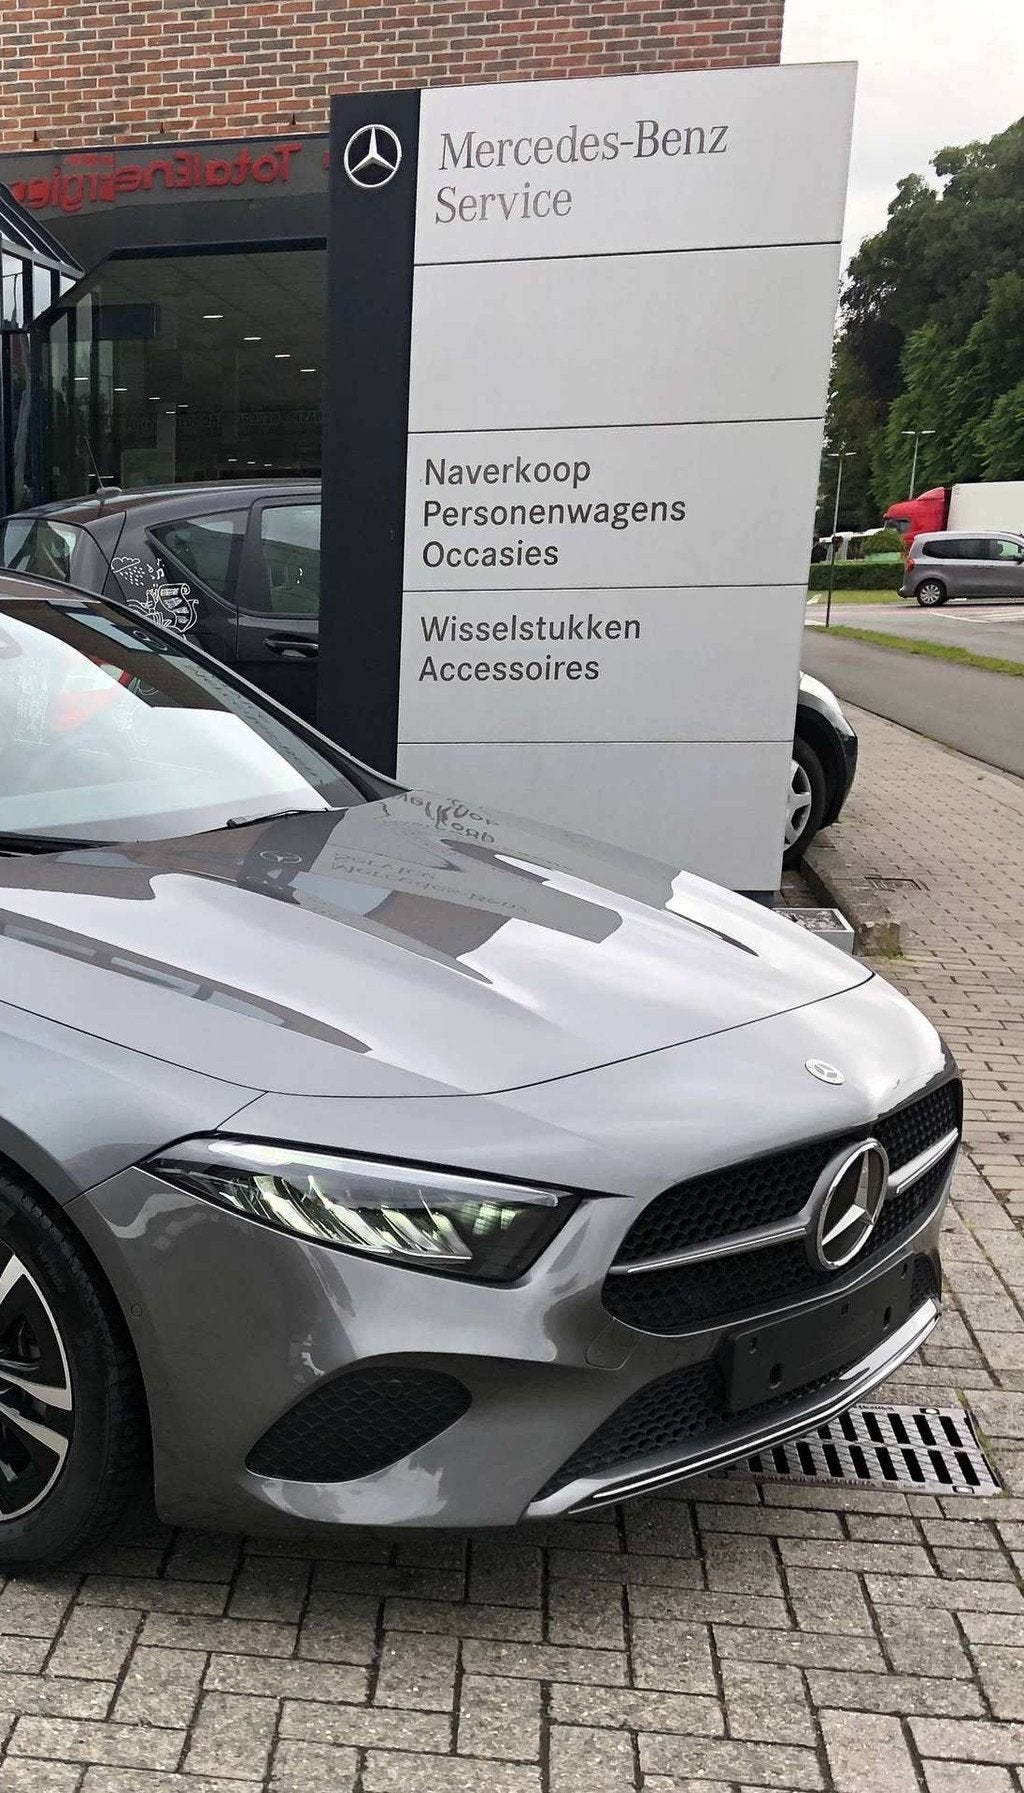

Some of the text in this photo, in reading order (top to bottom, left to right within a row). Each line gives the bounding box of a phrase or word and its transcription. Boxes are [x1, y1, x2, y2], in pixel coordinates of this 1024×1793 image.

[438, 119, 730, 171] Mercedes-Benz
[435, 181, 573, 225] Service
[424, 455, 592, 490] Naverkoop
[422, 499, 687, 531] Personenwagens
[421, 539, 560, 568] Occasies
[419, 613, 642, 644] Wisselstukken
[417, 653, 601, 682] Accessoires
